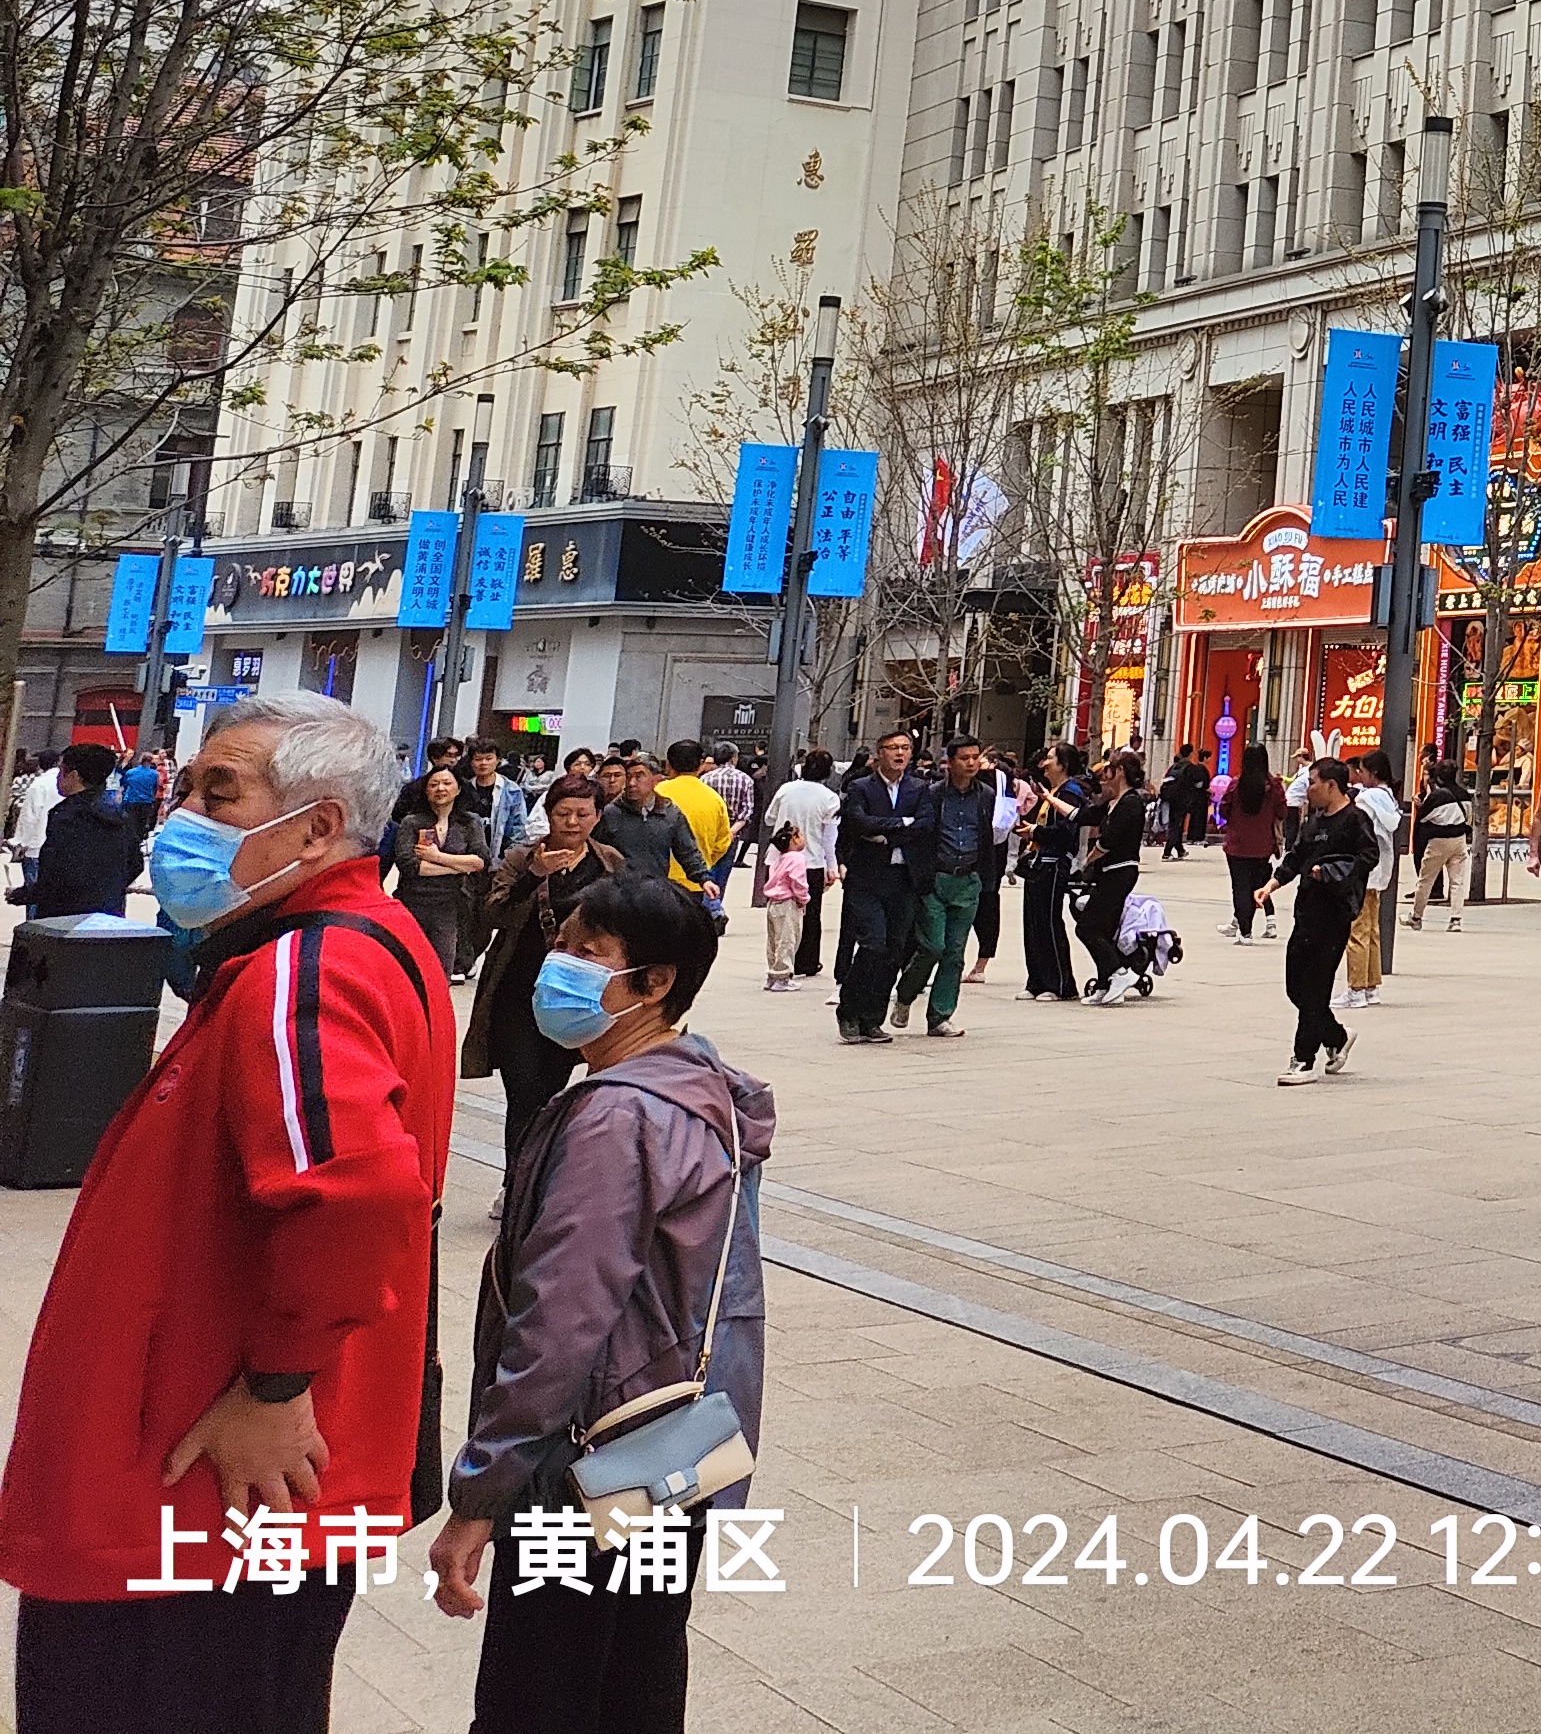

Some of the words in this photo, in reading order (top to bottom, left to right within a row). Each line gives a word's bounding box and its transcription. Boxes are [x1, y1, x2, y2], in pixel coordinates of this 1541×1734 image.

[1428, 397, 1449, 441] 文明
[1451, 399, 1473, 442] 富强
[1333, 381, 1357, 507] 人民城市为人民
[1353, 383, 1378, 508] 人民城市人民建
[1448, 455, 1468, 497] 民主
[743, 479, 763, 571] 保护未成年人健康成长
[820, 489, 838, 519] 公正
[841, 490, 857, 520] 自由
[757, 480, 778, 572] 净化未成年人成长环境
[816, 528, 834, 560] 法治
[835, 529, 853, 562] 平等
[410, 539, 431, 610] 做黄浦文明人
[426, 539, 447, 610] 创全国文明城
[493, 547, 508, 572] 爱国
[1243, 552, 1325, 601] 小酥福
[490, 577, 505, 602] 敬业
[1330, 694, 1385, 719] 大白
